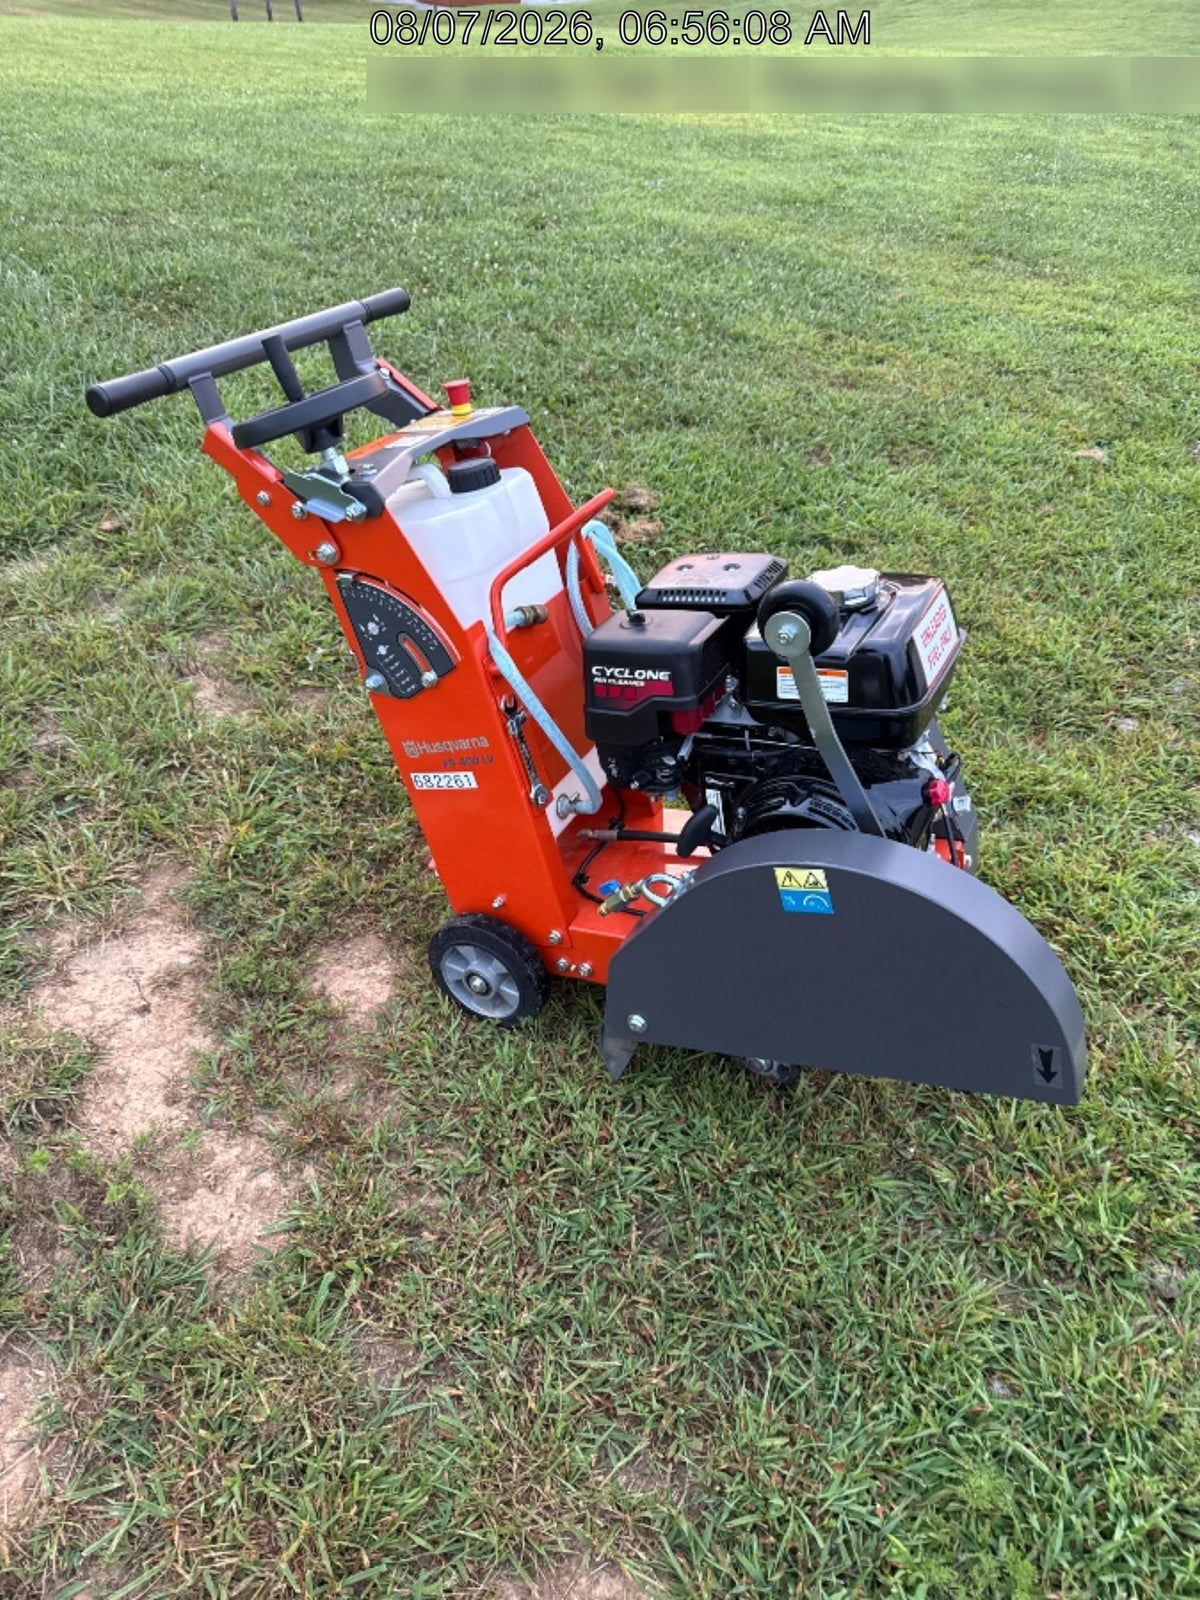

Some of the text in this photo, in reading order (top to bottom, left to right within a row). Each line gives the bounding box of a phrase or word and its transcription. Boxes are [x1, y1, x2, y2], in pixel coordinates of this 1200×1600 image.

[591, 666, 671, 681] CYCLONE
[420, 736, 489, 753] Husqvarna
[413, 774, 473, 788] 682261
